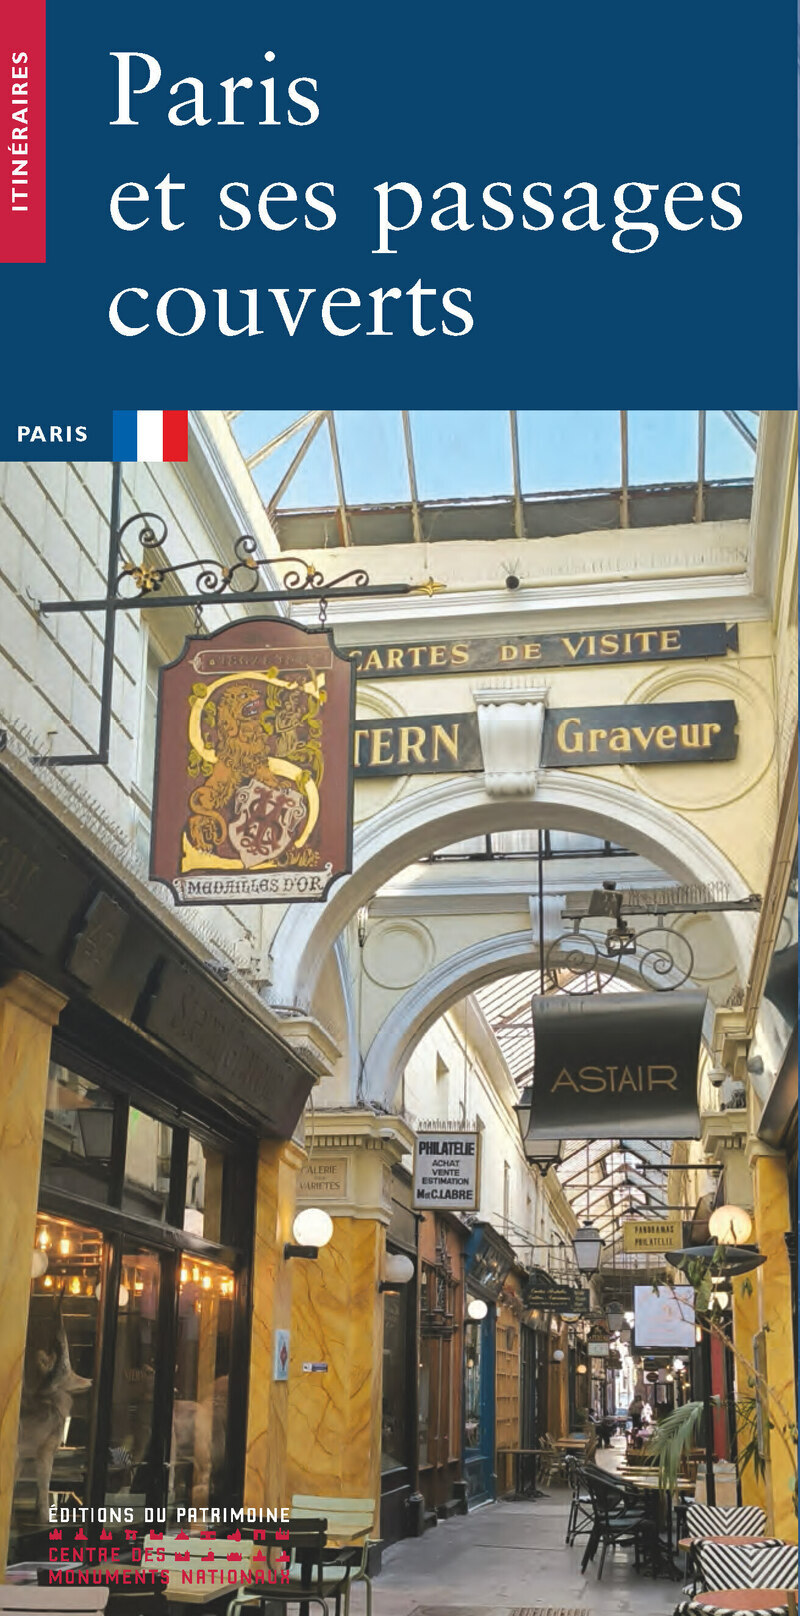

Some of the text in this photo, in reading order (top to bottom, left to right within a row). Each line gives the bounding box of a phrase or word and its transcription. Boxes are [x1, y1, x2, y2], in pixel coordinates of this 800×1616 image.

[500, 643, 541, 661] DE
[560, 629, 681, 659] VISITE
[556, 717, 721, 755] Graveur
[187, 876, 325, 895] MEDAILLES D'OR
[550, 1065, 679, 1094] ASTAIR
[419, 1141, 475, 1156] PHILATELIE
[432, 1159, 460, 1167] ACHAT
[432, 1168, 460, 1176] VENTE
[422, 1177, 469, 1185] ESTIMATION
